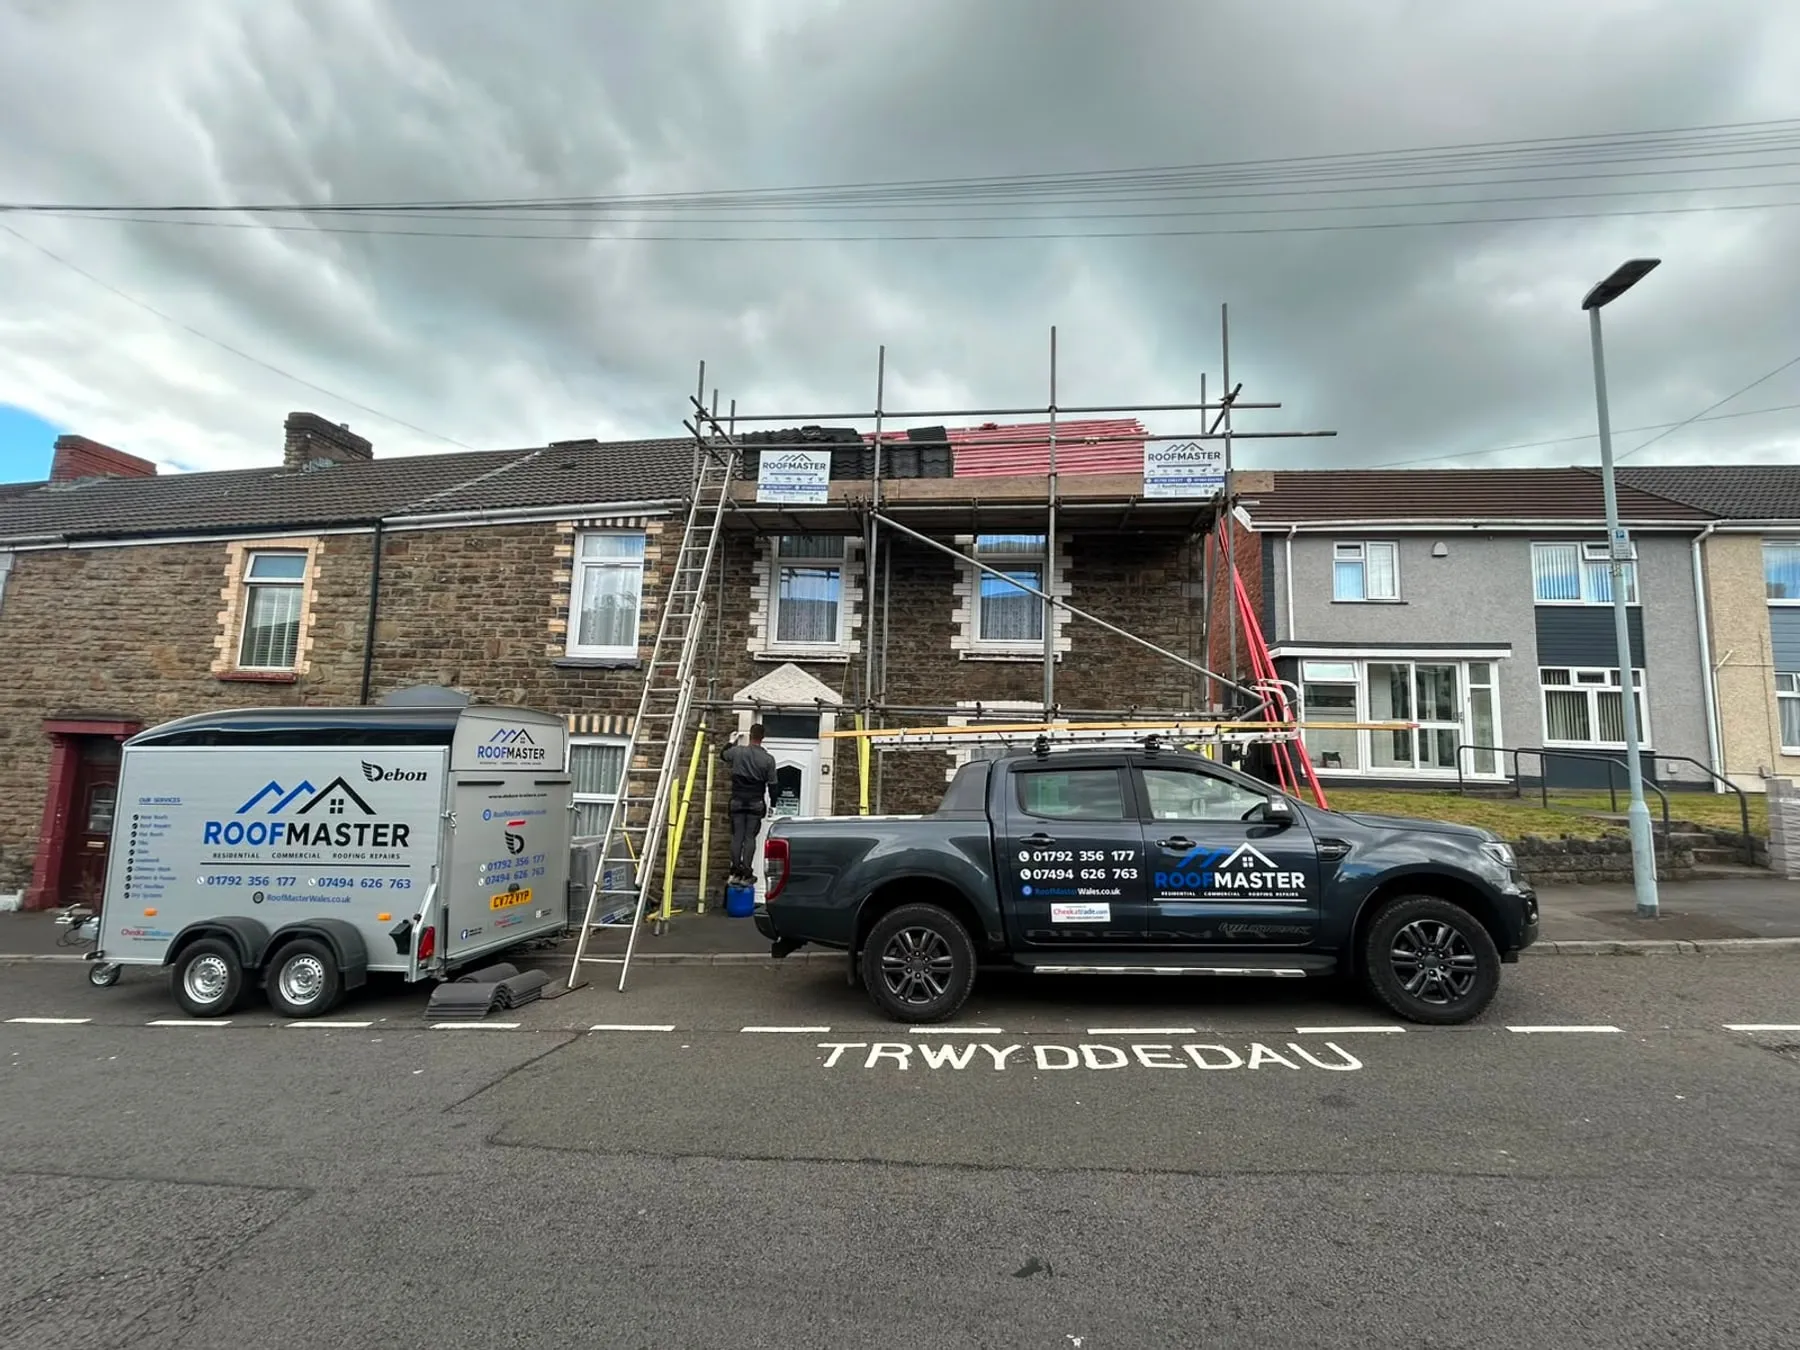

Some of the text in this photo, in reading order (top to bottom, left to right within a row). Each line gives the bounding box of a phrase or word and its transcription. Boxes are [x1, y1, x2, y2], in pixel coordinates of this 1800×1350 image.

[1148, 452, 1220, 461] ROOFMASTER
[763, 462, 826, 470] ROOFMASTER
[477, 746, 545, 760] ROOFMASTER
[361, 760, 428, 782] Debon
[203, 821, 410, 848] ROOFMASTER
[271, 852, 321, 860] COMMERCIAL
[487, 854, 545, 871] 01792 356 177
[1033, 851, 1135, 861] 01792 356 177
[485, 867, 545, 885] 07494 626 763
[1033, 869, 1138, 879] 07494 626 763
[1154, 872, 1306, 888] ROOFMASTER
[207, 876, 411, 889] 01792 356 177 07494 626 763
[266, 894, 351, 904] RoofMasterWales.co.uk
[817, 1042, 1364, 1072] TRWYDDEDAU
